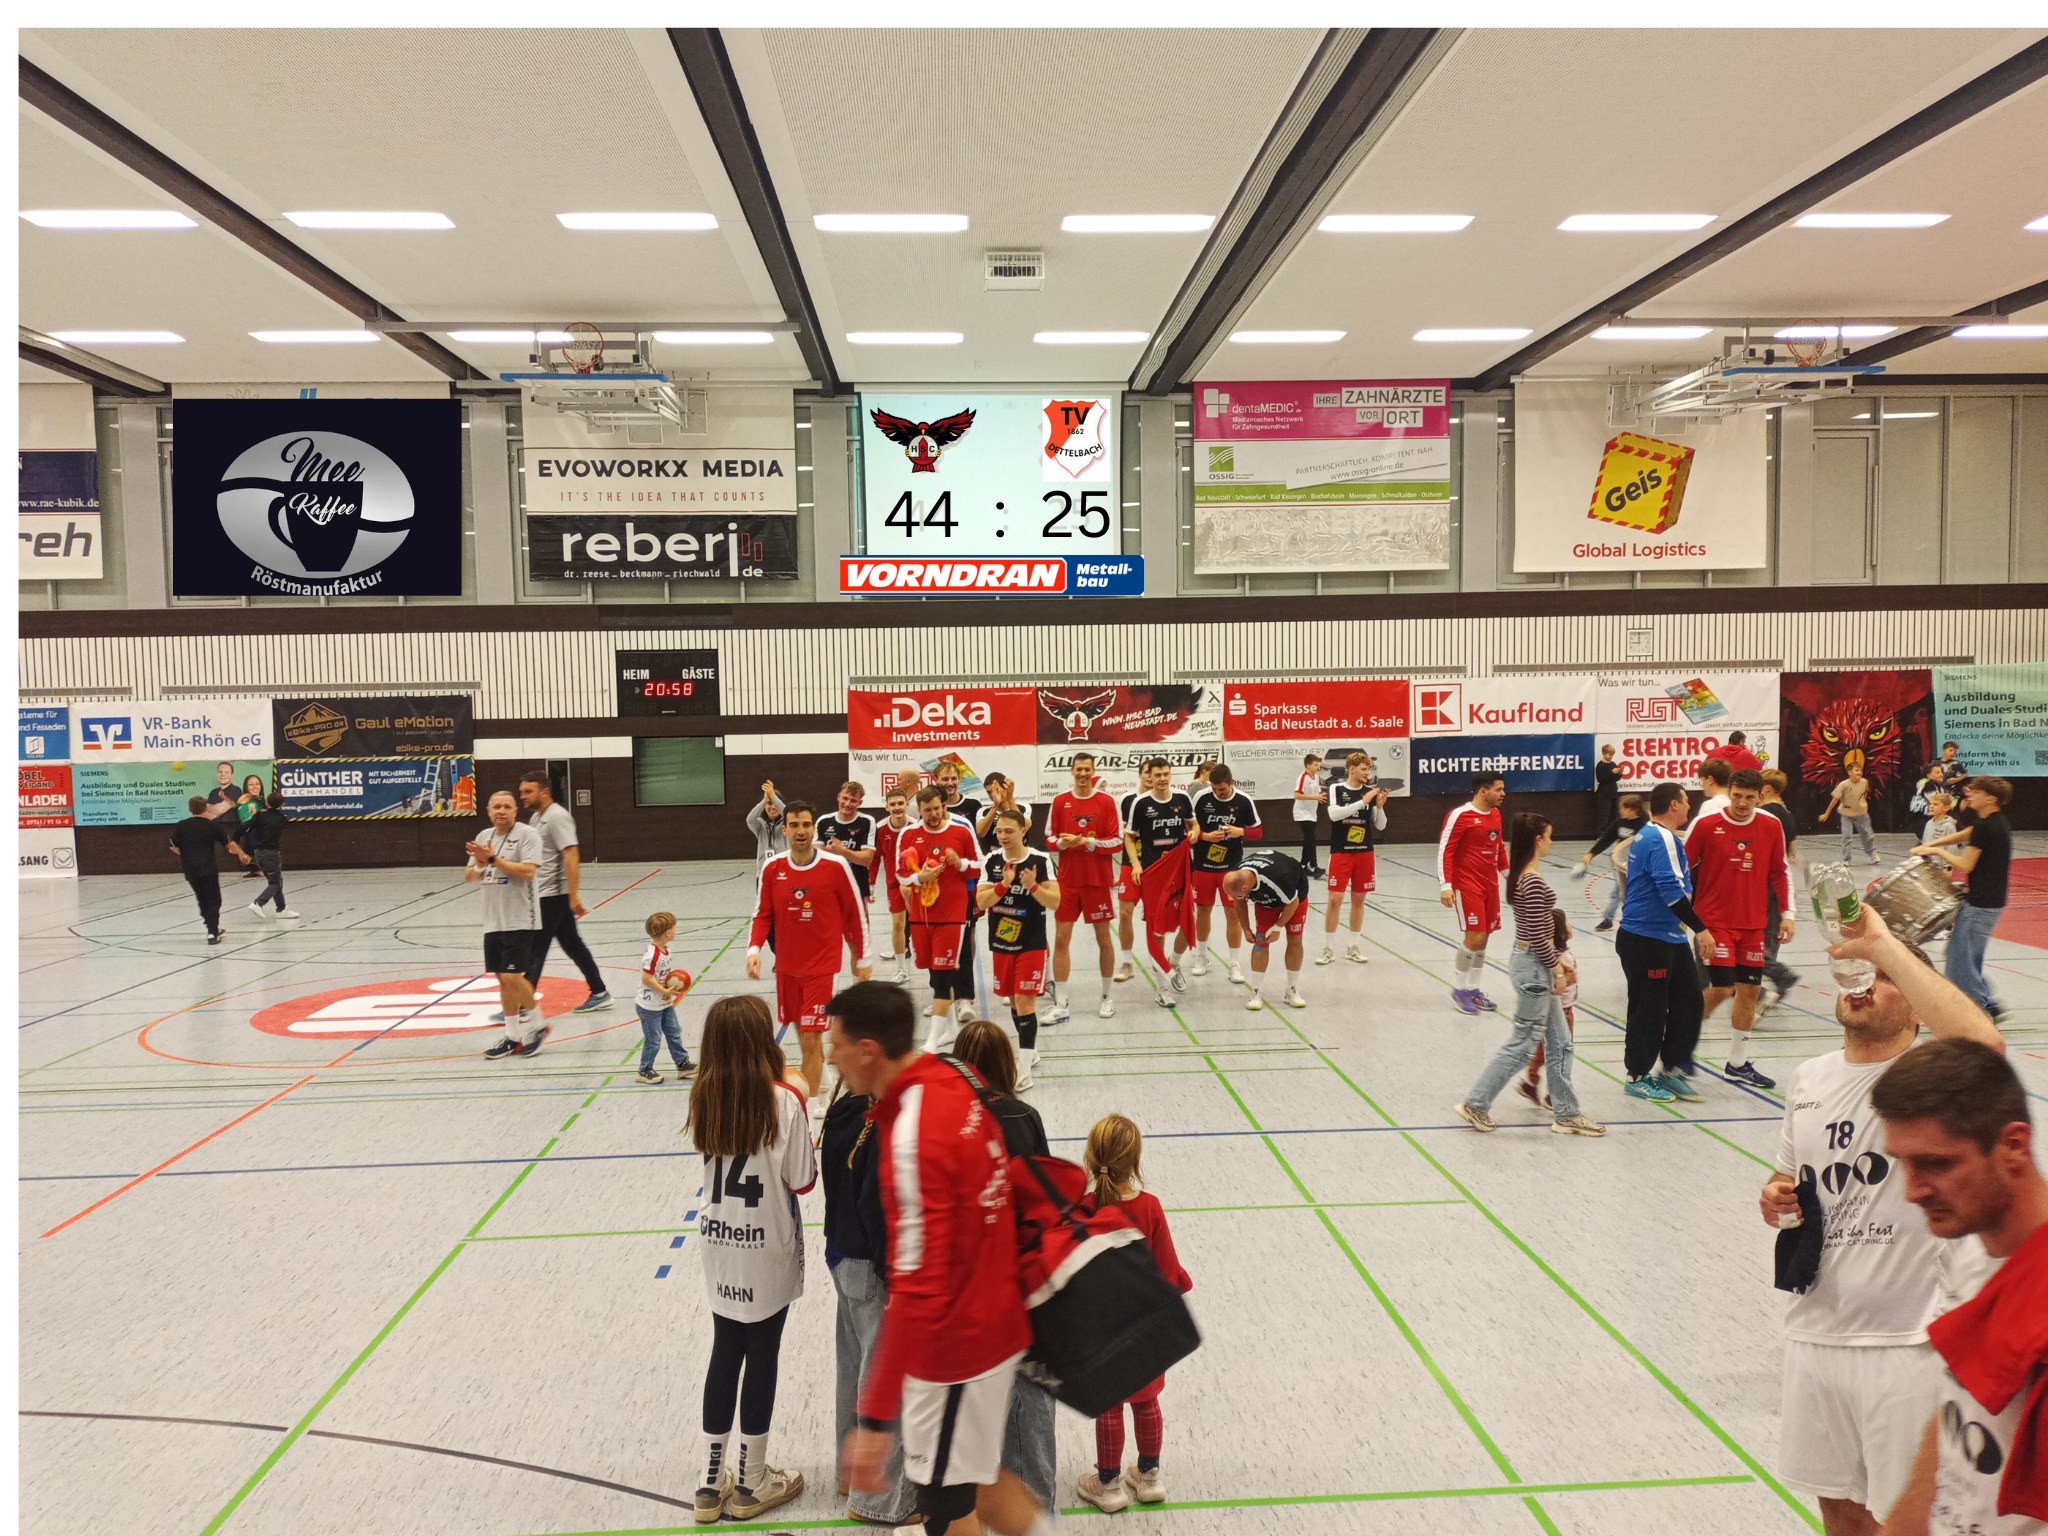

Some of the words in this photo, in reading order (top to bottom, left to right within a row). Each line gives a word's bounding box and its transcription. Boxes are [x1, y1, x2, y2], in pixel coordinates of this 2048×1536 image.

[1315, 396, 1338, 405] IHRE
[1345, 387, 1444, 404] ZAHNÄRZTE
[1359, 410, 1380, 421] VOR
[1386, 410, 1421, 425] ORT
[538, 459, 688, 478] EVOWORKX
[702, 459, 784, 478] MEDIA
[1330, 462, 1404, 481] www.ossig-online.de
[560, 492, 589, 502] IT'S
[598, 492, 622, 502] THE
[631, 491, 663, 502] IDEA
[671, 491, 705, 502] THAT
[714, 491, 766, 502] COUNTS
[1349, 492, 1377, 500] Meiningen
[1421, 491, 1443, 499] Ostheim
[1604, 468, 1662, 512] Geis
[1572, 543, 1627, 558] Global
[1632, 542, 1707, 560] Logistics
[564, 569, 580, 579] dr.
[742, 565, 764, 578] de
[622, 669, 650, 680] HEIM
[682, 666, 715, 680] GÄSTE
[644, 682, 693, 696] 20:58
[1597, 678, 1619, 688] Was
[1621, 678, 1637, 687] wir
[1944, 692, 2016, 703] Ausbildung
[892, 695, 992, 729] Deka
[1102, 706, 1162, 727] WWW.HSC-BAD
[1254, 702, 1318, 718] Sparkasse
[1469, 701, 1583, 724] Kaufland
[1944, 705, 1968, 716] und
[1971, 705, 2013, 715] Duales
[32, 723, 67, 731] Fassaden
[142, 716, 212, 730] VR-Bank
[287, 720, 345, 737] eBike-PRO.de
[355, 716, 391, 730] Gaul
[394, 716, 455, 728] eMotion
[1122, 712, 1178, 731] -NEUSTADT.DE
[1191, 719, 1217, 731] DRUCK
[1254, 719, 1278, 730] Bad
[1281, 717, 1339, 730] Neustadt
[1341, 719, 1352, 729] a.
[1355, 717, 1367, 728] d.
[1369, 716, 1404, 728] Saale
[1944, 719, 1996, 729] Siemens
[1998, 718, 2011, 728] in
[2013, 718, 2037, 728] Bad
[143, 734, 235, 749] Main-Rhön
[240, 733, 262, 747] eG
[892, 729, 981, 743] Investments
[395, 743, 455, 753] ebike-pro.de
[1230, 749, 1267, 758] WELCHER
[1268, 748, 1280, 756] IST
[1280, 748, 1294, 756] IHR
[1622, 736, 1720, 757] ELEKTRO
[852, 753, 874, 762] Was
[875, 753, 891, 761] wir
[1991, 750, 2007, 758] the
[280, 768, 363, 787] GÜNTHER
[382, 776, 422, 784] AUFGESTELLT
[81, 782, 122, 790] Ausbildung
[165, 780, 196, 788] Studium
[283, 788, 361, 796] FACHHANDEL
[281, 803, 364, 813] www.guentherfachhandel.de
[1165, 828, 1170, 836] 5
[1004, 895, 1014, 905] 26
[812, 1004, 826, 1015] 18
[1825, 1120, 1855, 1150] 18
[708, 1219, 765, 1242] Rhein
[1868, 1222, 1893, 1238] Fest
[708, 1239, 766, 1250] RHÖN-SAALE
[716, 1281, 754, 1303] HAHN
